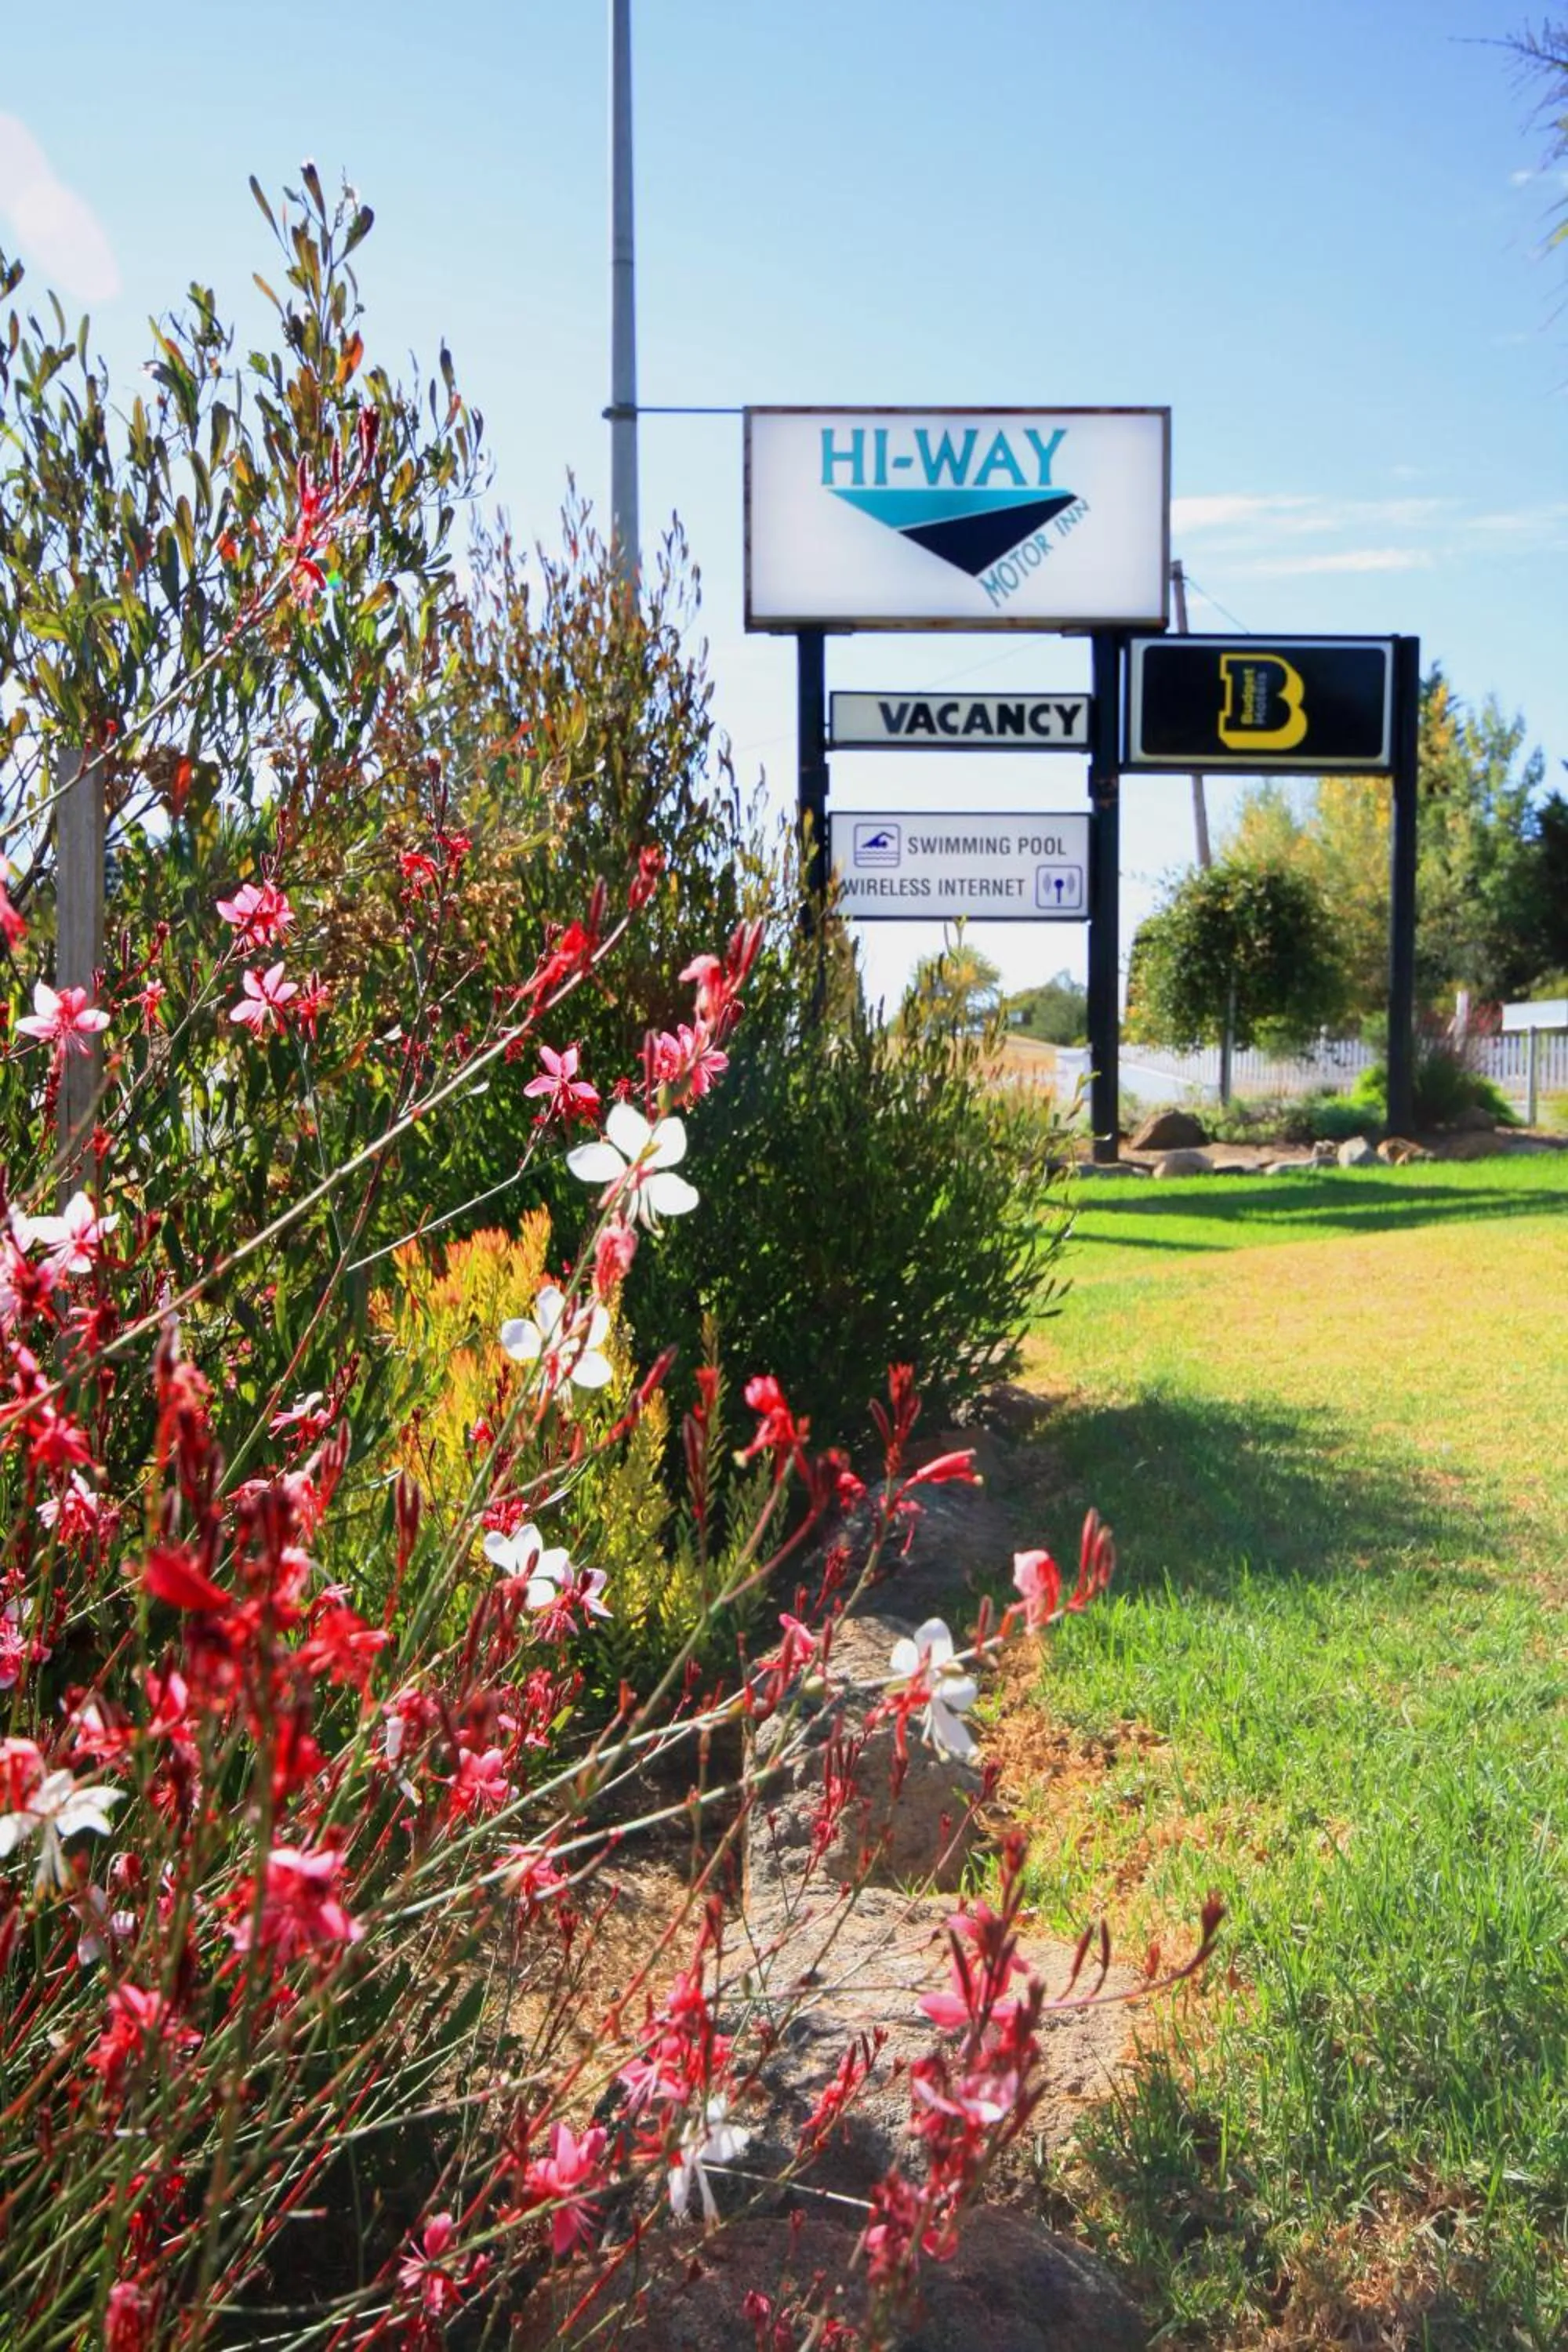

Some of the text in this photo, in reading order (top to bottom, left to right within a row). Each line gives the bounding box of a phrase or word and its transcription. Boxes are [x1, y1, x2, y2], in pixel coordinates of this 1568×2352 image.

[821, 429, 1067, 485] HI-WAY
[979, 499, 1091, 608] MOTOR INN
[878, 702, 1081, 736] VACANCY
[907, 837, 1067, 855] SWIMMING POOL
[842, 878, 1025, 897] WIRELESS INTERNET
